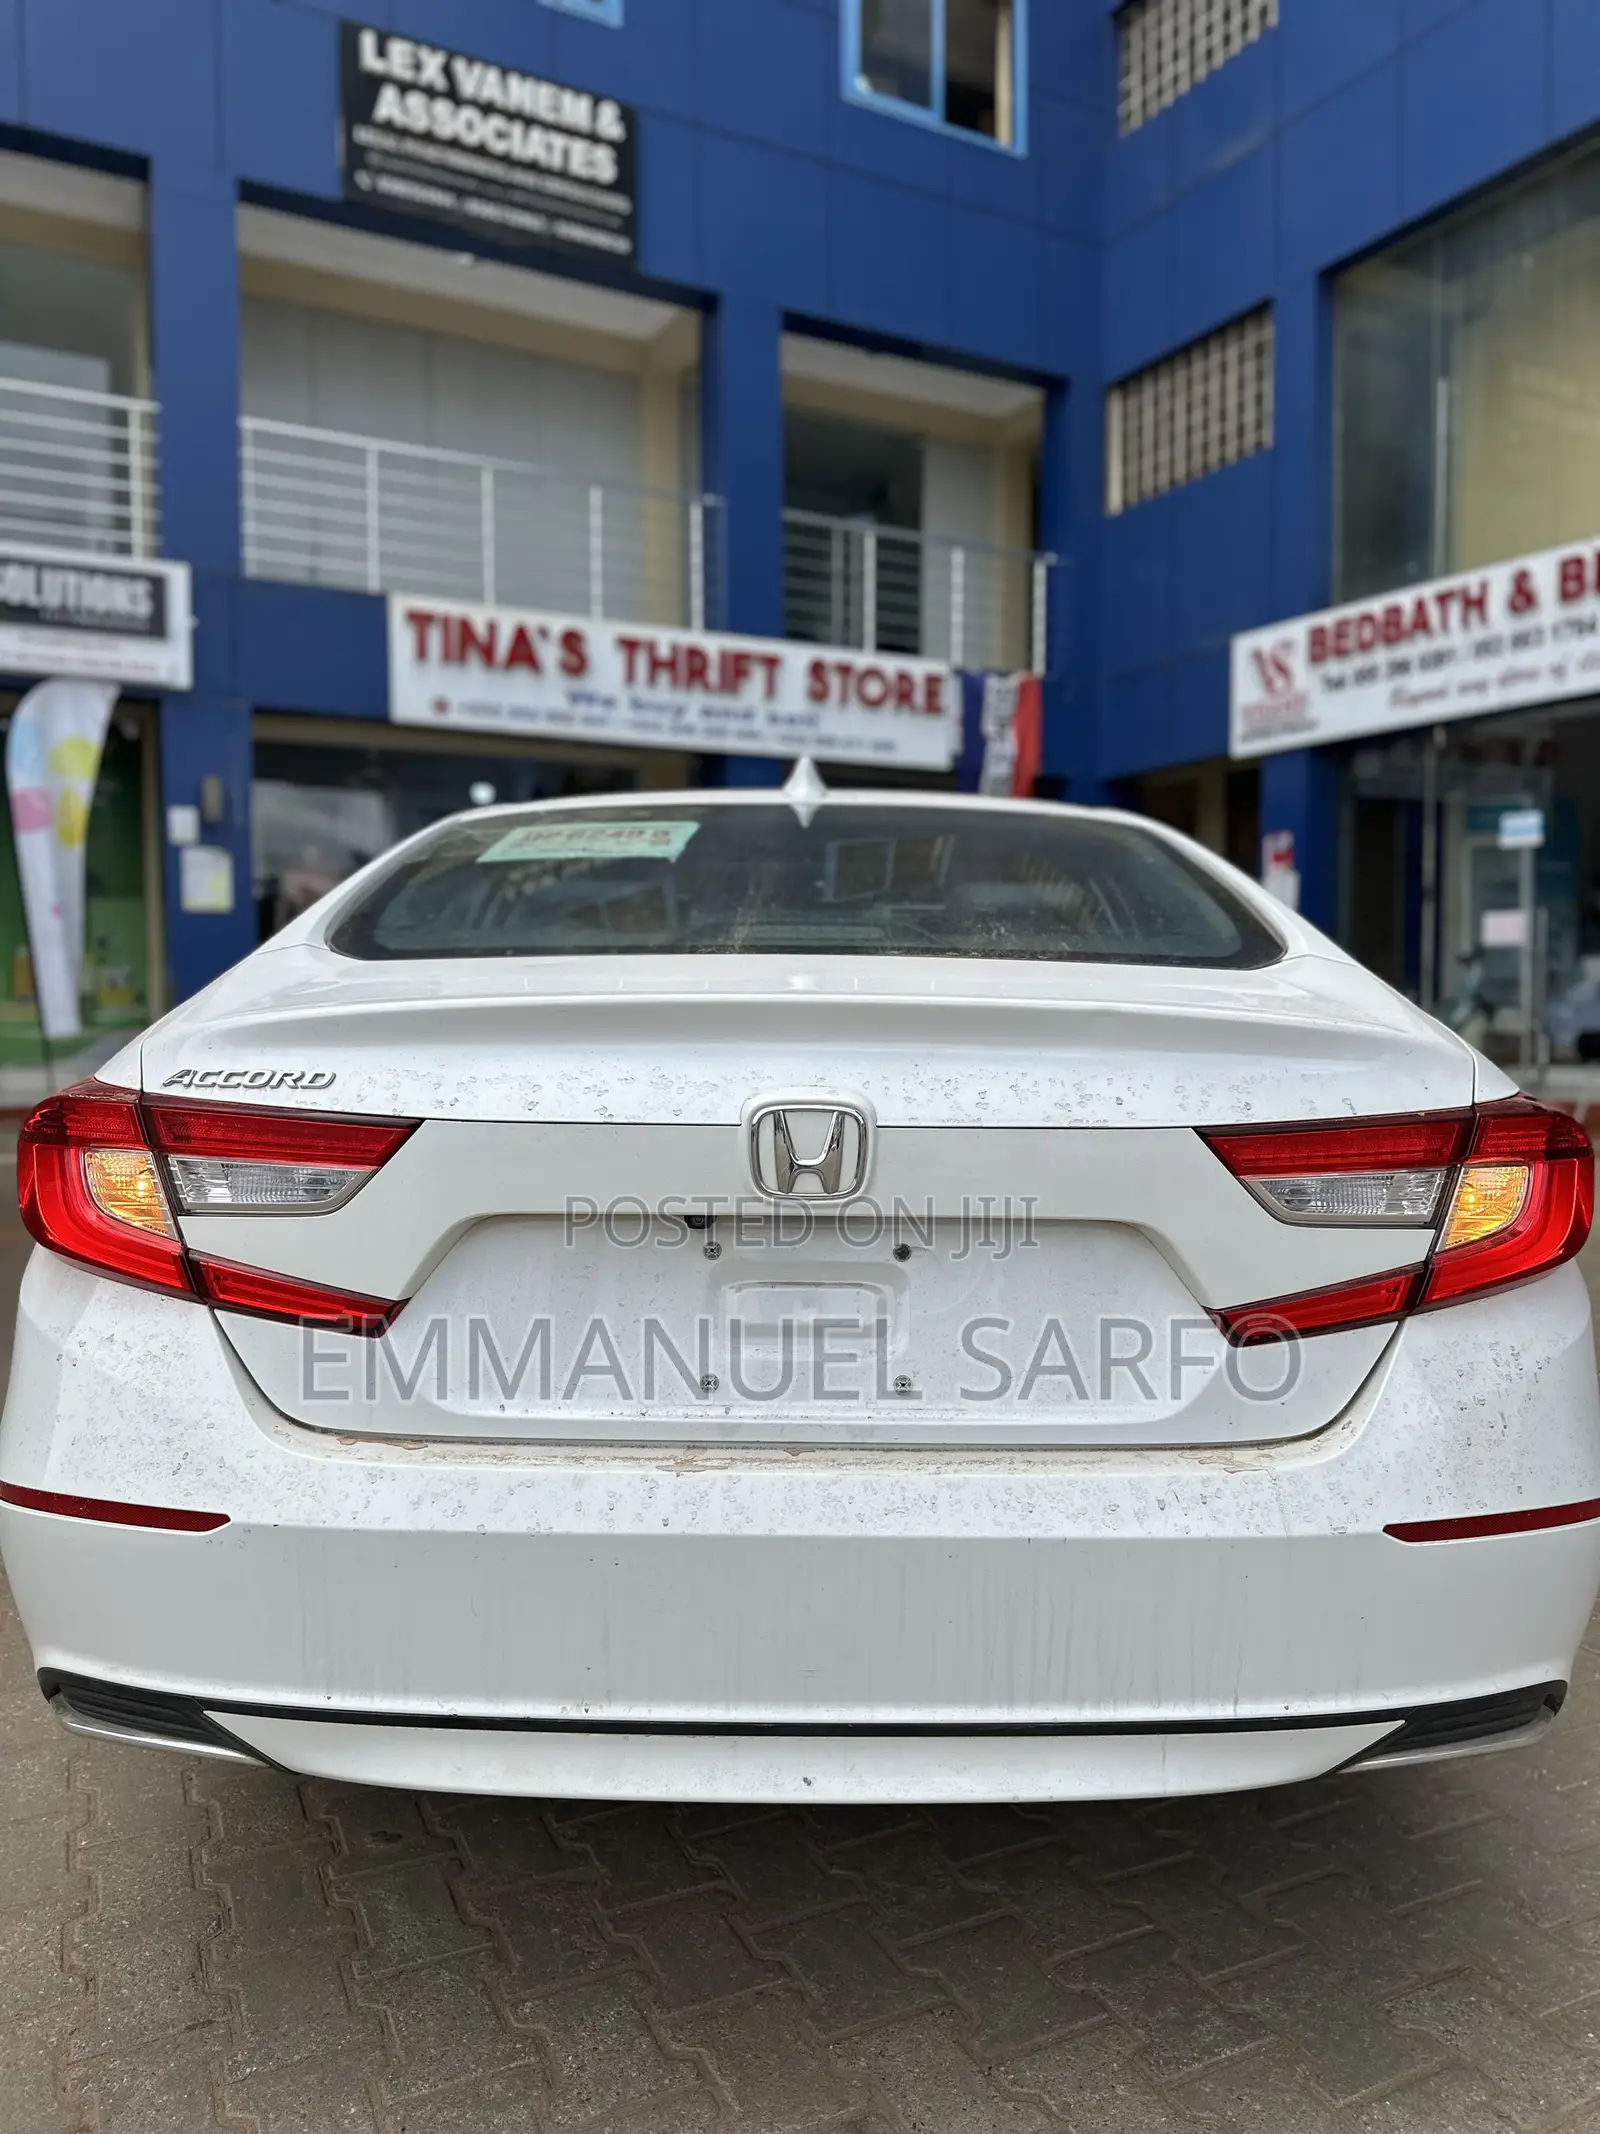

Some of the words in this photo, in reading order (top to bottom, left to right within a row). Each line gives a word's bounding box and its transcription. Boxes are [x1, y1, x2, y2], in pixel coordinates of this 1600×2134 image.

[358, 28, 449, 91] LEX
[595, 98, 626, 142] &
[371, 82, 619, 186] ASSOCIATES
[405, 609, 590, 679] TINA'S
[616, 635, 781, 702] THRIFT
[808, 658, 945, 715] STORE
[1306, 580, 1488, 665] BEDBATH
[1507, 567, 1539, 616] &
[163, 1069, 337, 1089] ACCORD
